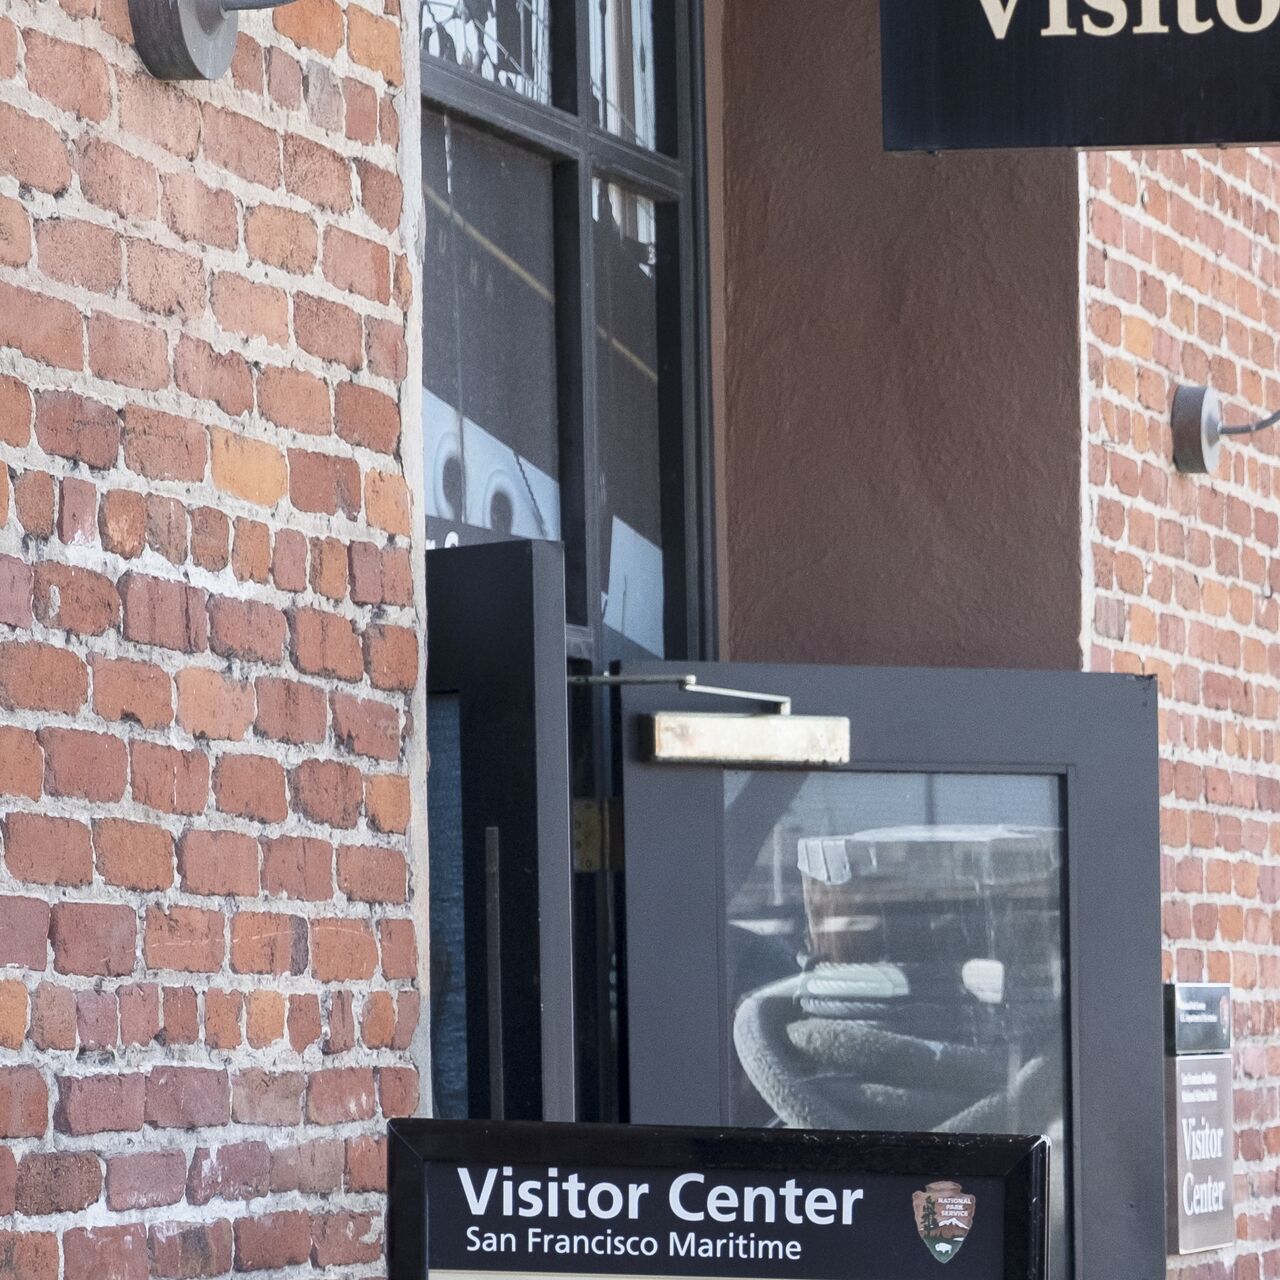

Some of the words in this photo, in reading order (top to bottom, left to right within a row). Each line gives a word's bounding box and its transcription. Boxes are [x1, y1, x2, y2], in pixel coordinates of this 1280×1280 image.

[1181, 1116, 1223, 1161] Visitor
[458, 1167, 649, 1221] Visitor
[670, 1173, 864, 1225] Center
[1182, 1172, 1224, 1216] Center
[466, 1225, 517, 1253] San
[527, 1228, 658, 1257] Francisco
[669, 1231, 802, 1261] Maritime
